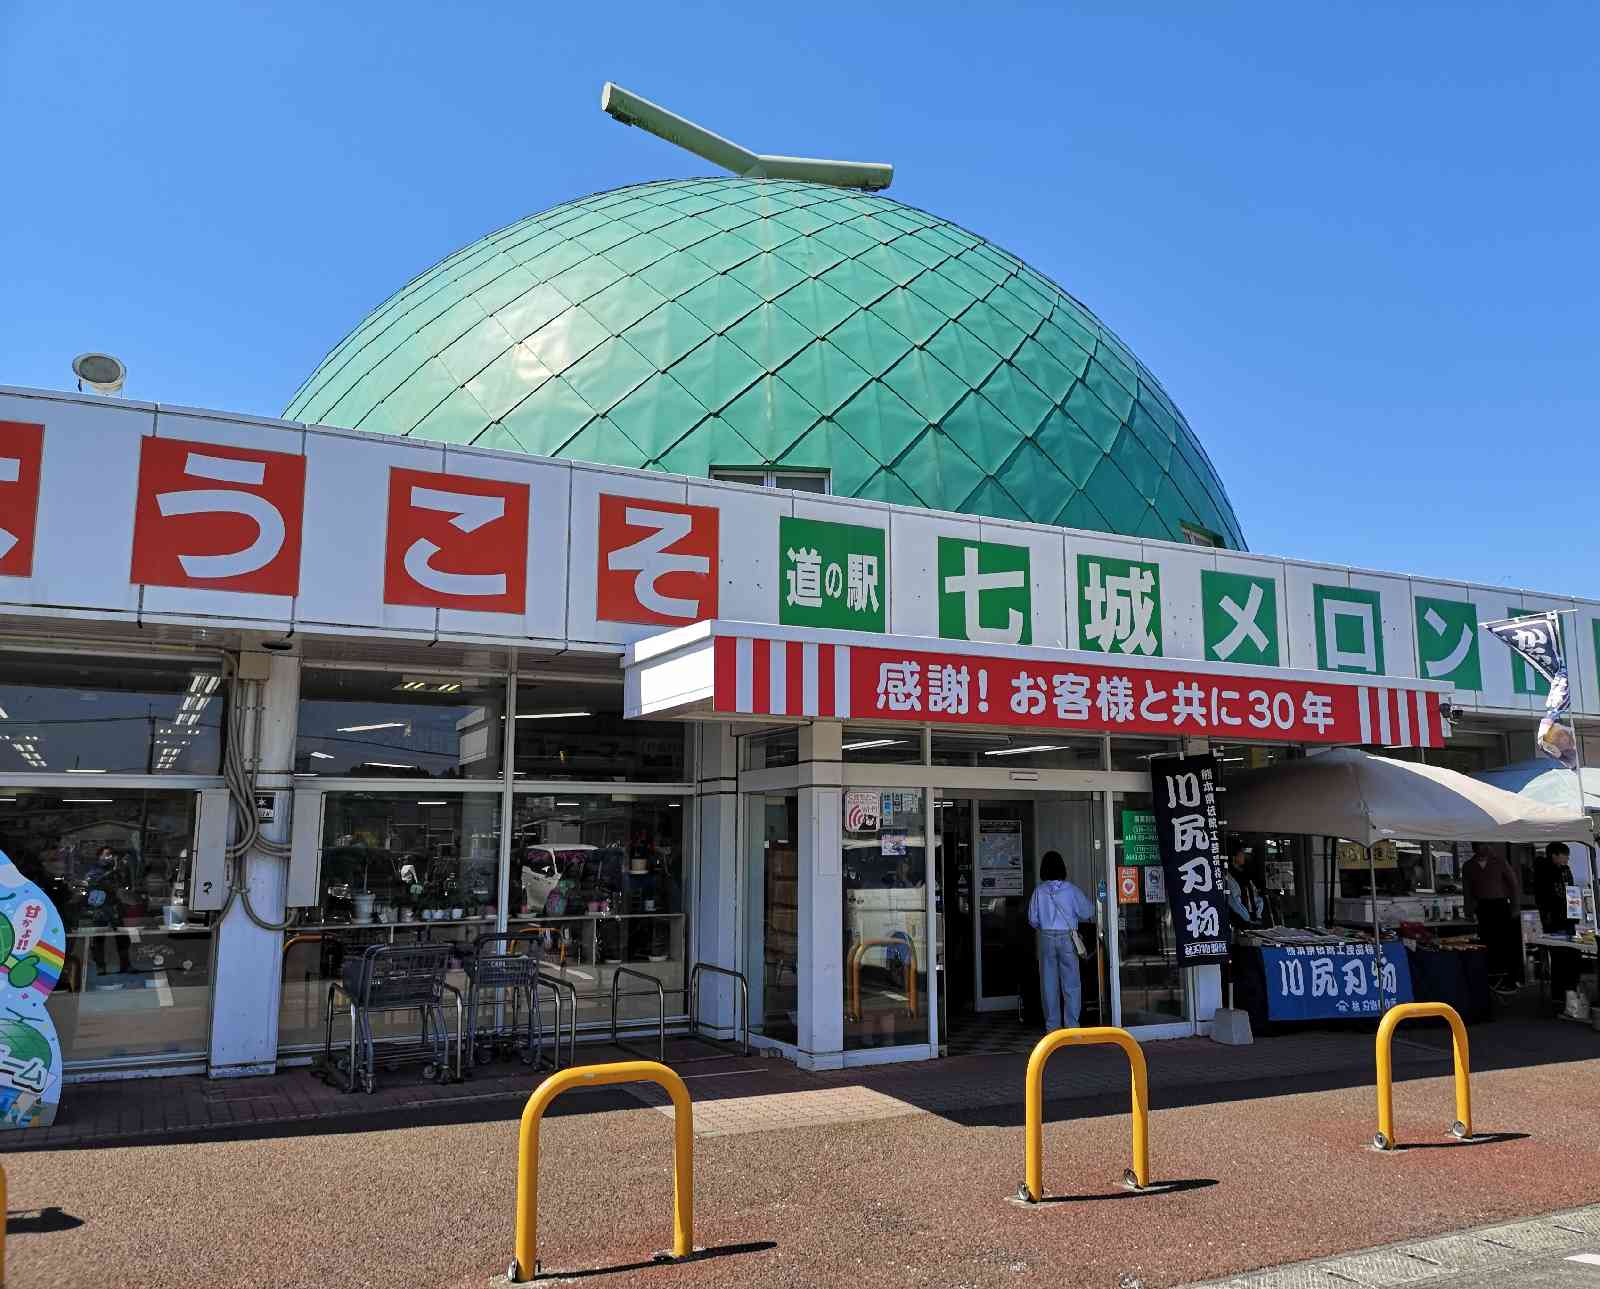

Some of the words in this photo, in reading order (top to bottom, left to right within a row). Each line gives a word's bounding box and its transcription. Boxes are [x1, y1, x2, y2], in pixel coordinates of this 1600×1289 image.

[0, 452, 710, 618] うこそ
[786, 547, 880, 613] 道の駅
[944, 547, 1536, 691] 七城メロン
[876, 661, 988, 715] 感謝!
[1010, 671, 1335, 734] お客様と共に30年
[1166, 772, 1220, 939] 川尻刃物
[1278, 956, 1397, 998] 川尻刃物
